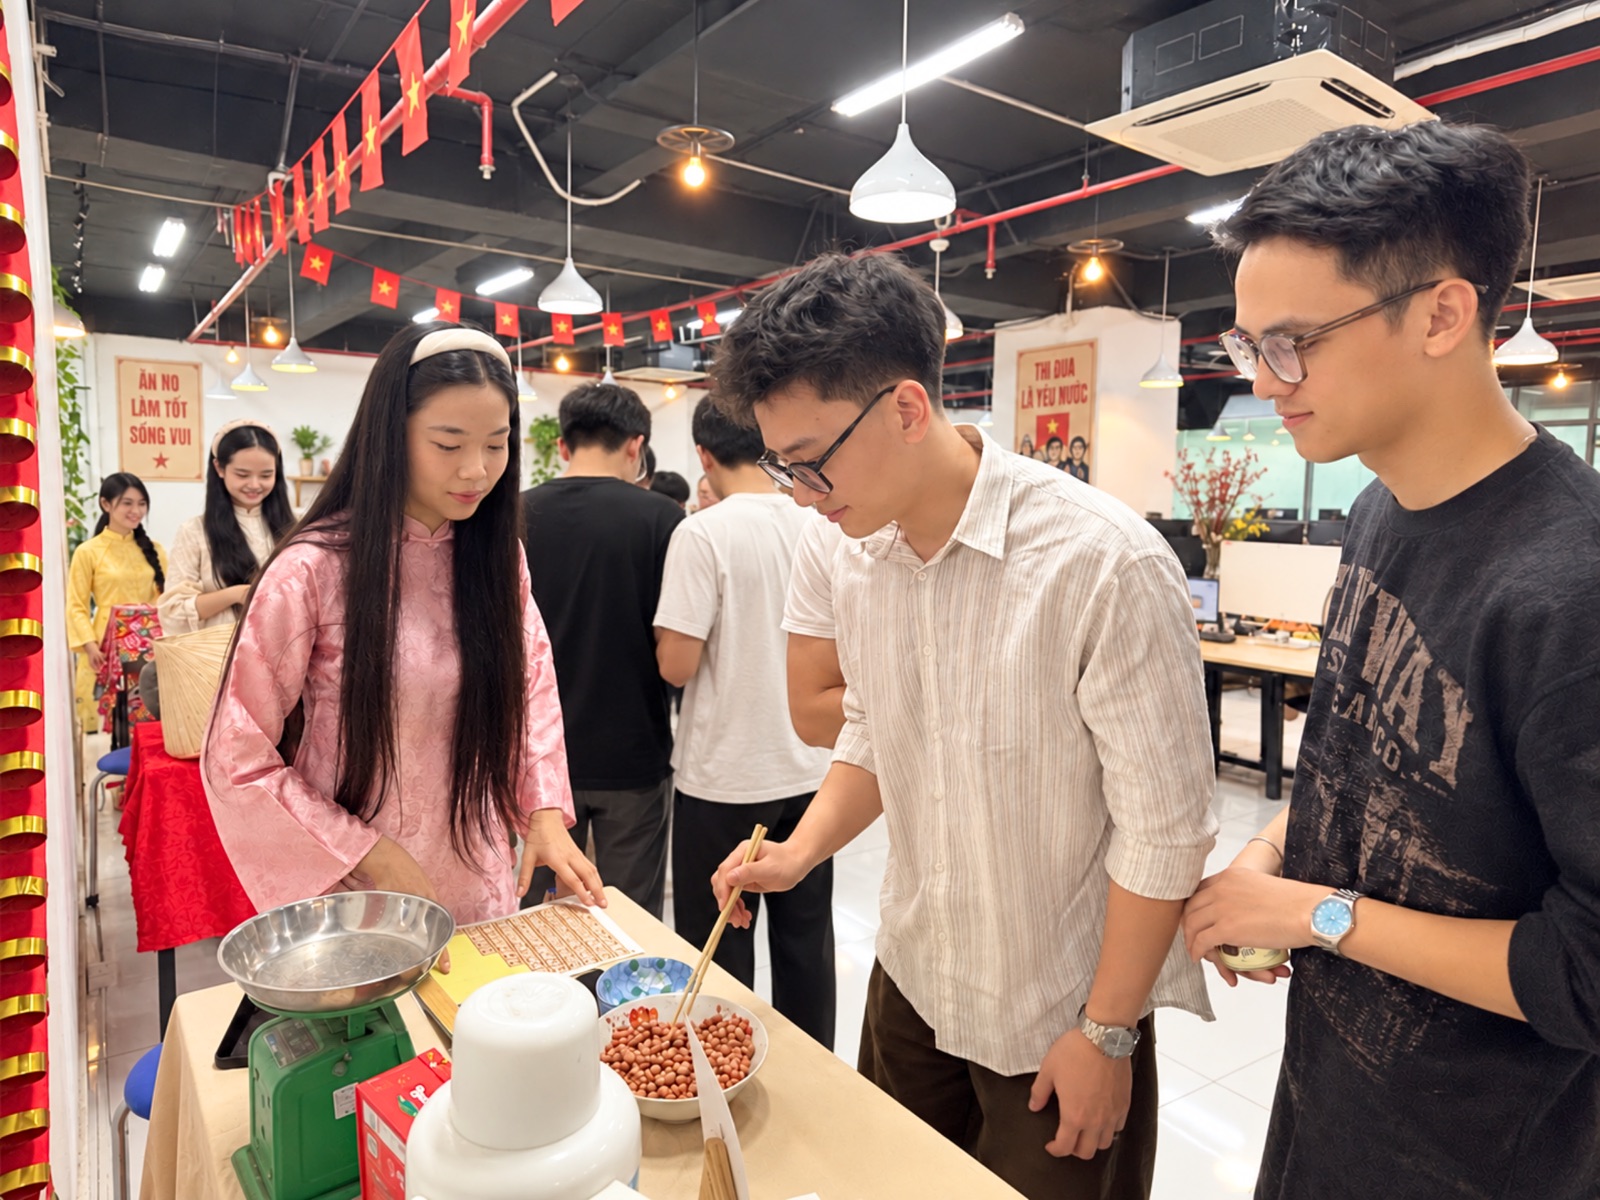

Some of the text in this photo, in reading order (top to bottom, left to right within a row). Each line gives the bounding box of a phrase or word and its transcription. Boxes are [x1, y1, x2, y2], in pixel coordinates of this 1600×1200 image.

[138, 368, 180, 392] ĂN NO
[1034, 357, 1075, 381] THI ĐUA
[131, 395, 188, 419] LÀM TỐT
[1021, 385, 1034, 410] LÀ
[129, 421, 191, 446] SỐNG VUI
